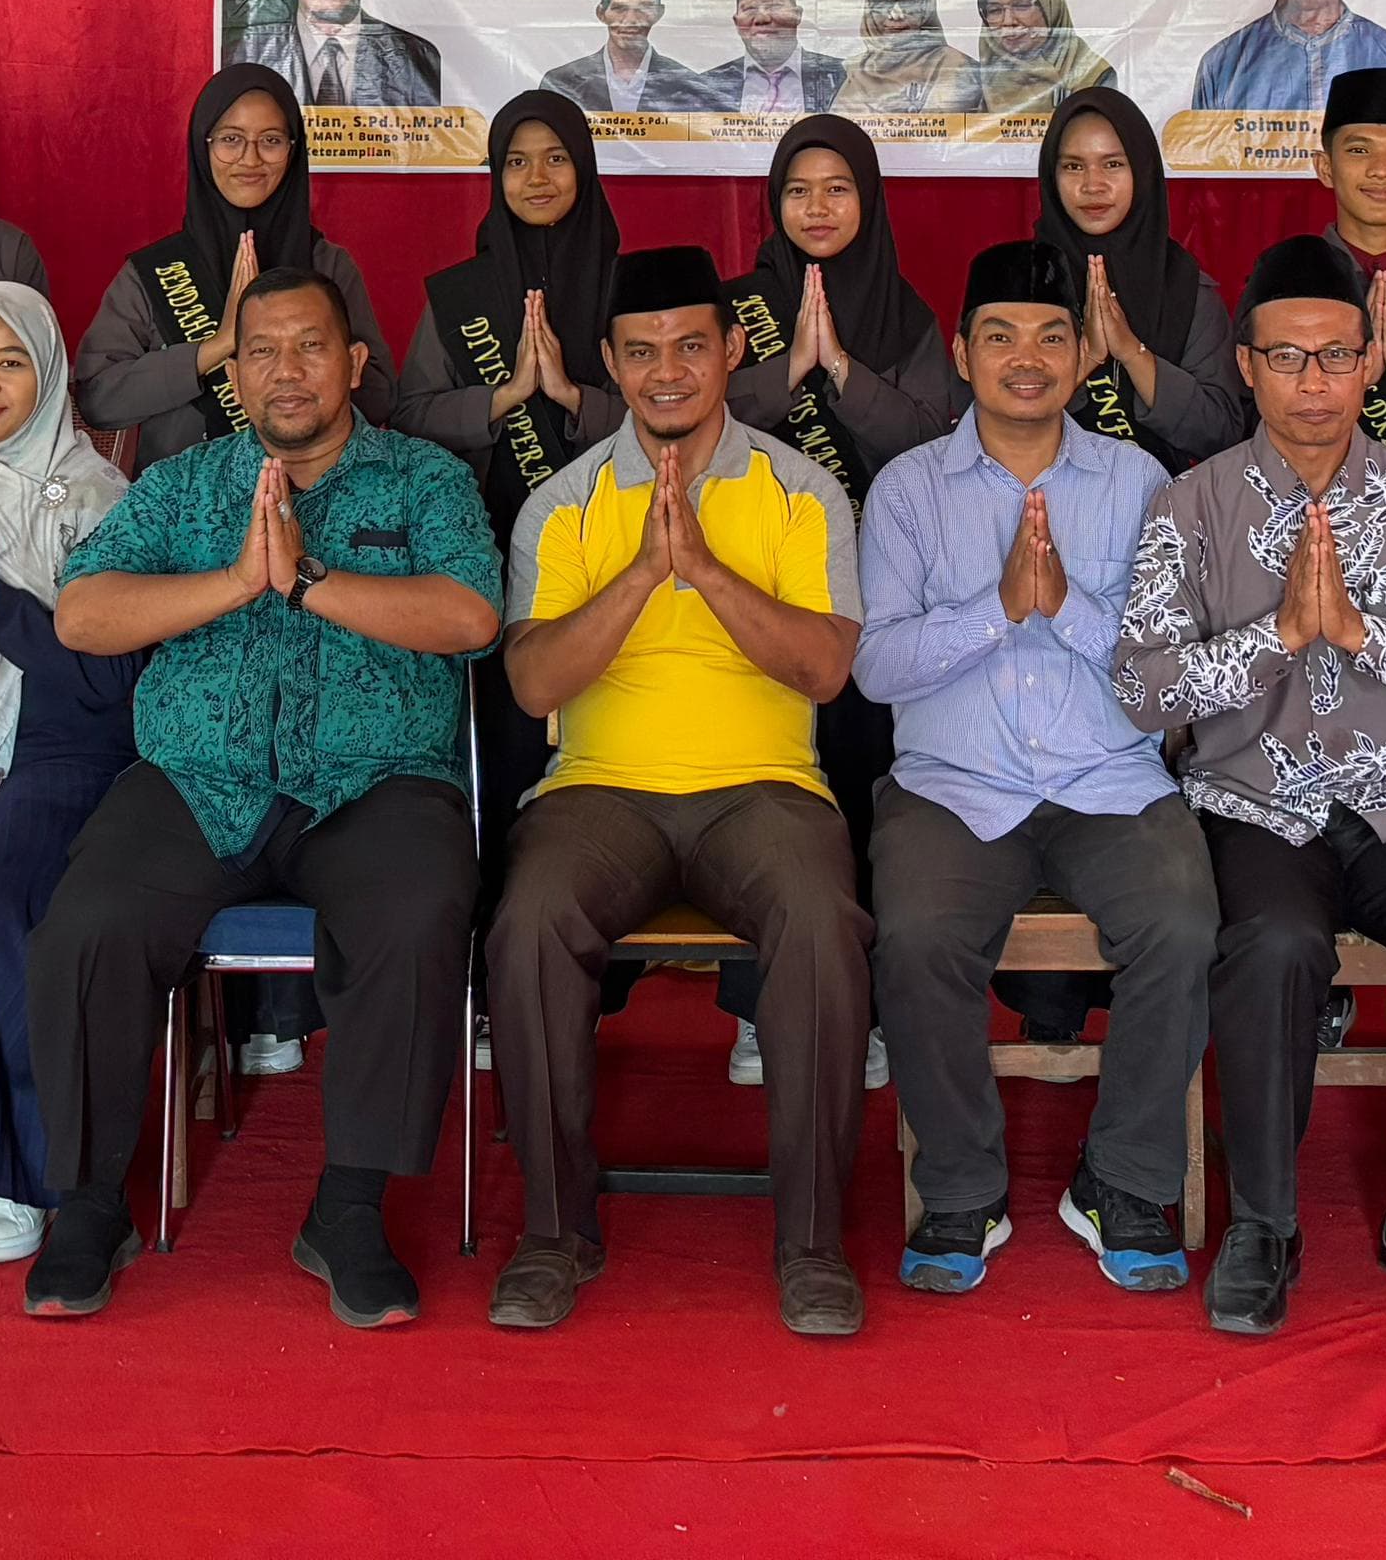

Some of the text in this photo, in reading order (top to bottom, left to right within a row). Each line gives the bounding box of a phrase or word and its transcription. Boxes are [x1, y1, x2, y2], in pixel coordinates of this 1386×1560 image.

[302, 115, 347, 130] rian,
[587, 116, 636, 126] skandar,
[1234, 117, 1318, 134] Soimun,
[313, 131, 430, 144] MAN 1 Bungo Plus
[882, 129, 948, 138] KURIKULUM
[731, 294, 787, 363] KETUA
[460, 316, 512, 386] DIVIS
